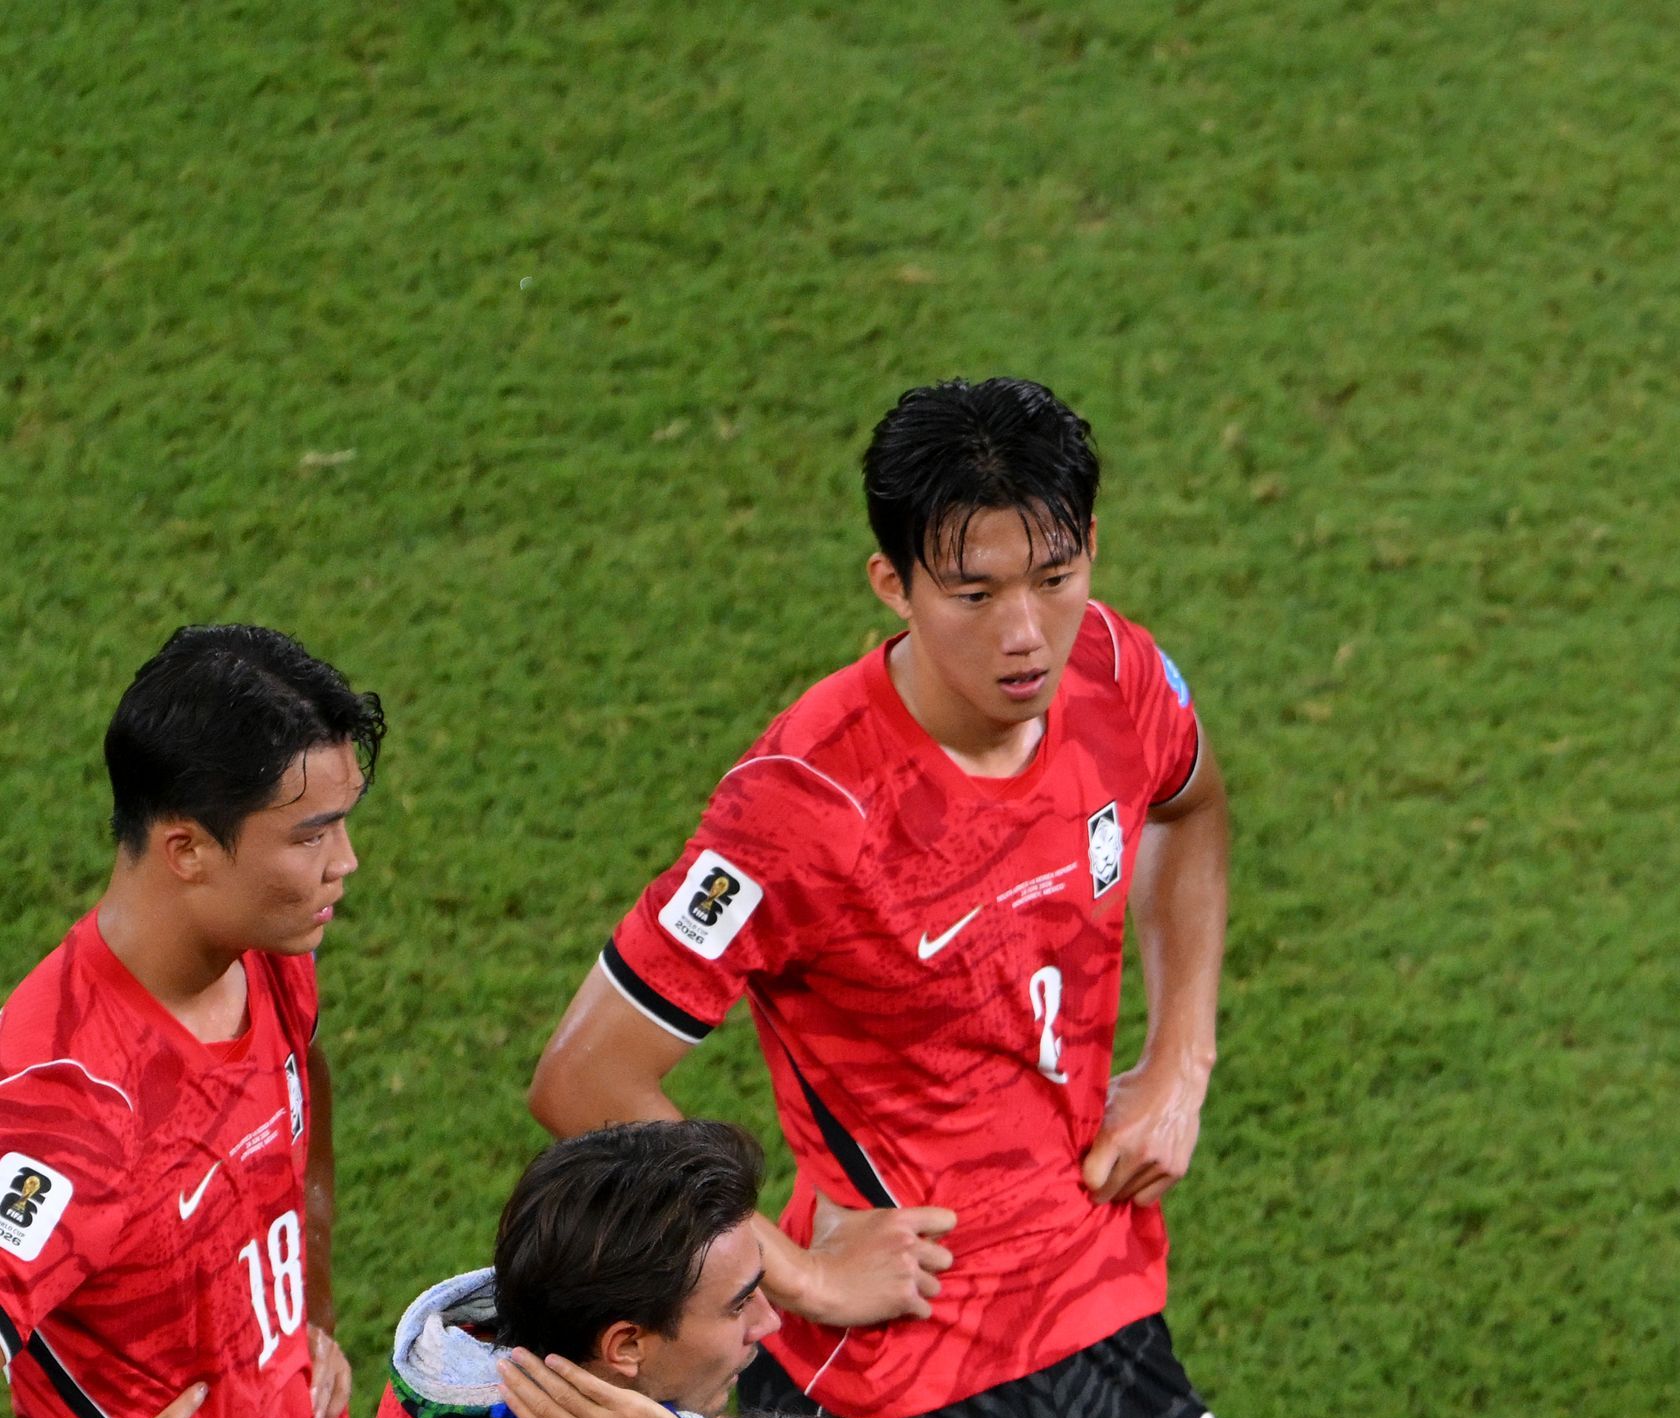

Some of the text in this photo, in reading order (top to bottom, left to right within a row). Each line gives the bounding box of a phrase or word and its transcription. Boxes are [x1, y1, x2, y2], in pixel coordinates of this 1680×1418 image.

[674, 920, 705, 945] 2026
[1029, 965, 1068, 1084] 2
[238, 1210, 303, 1371] 18
